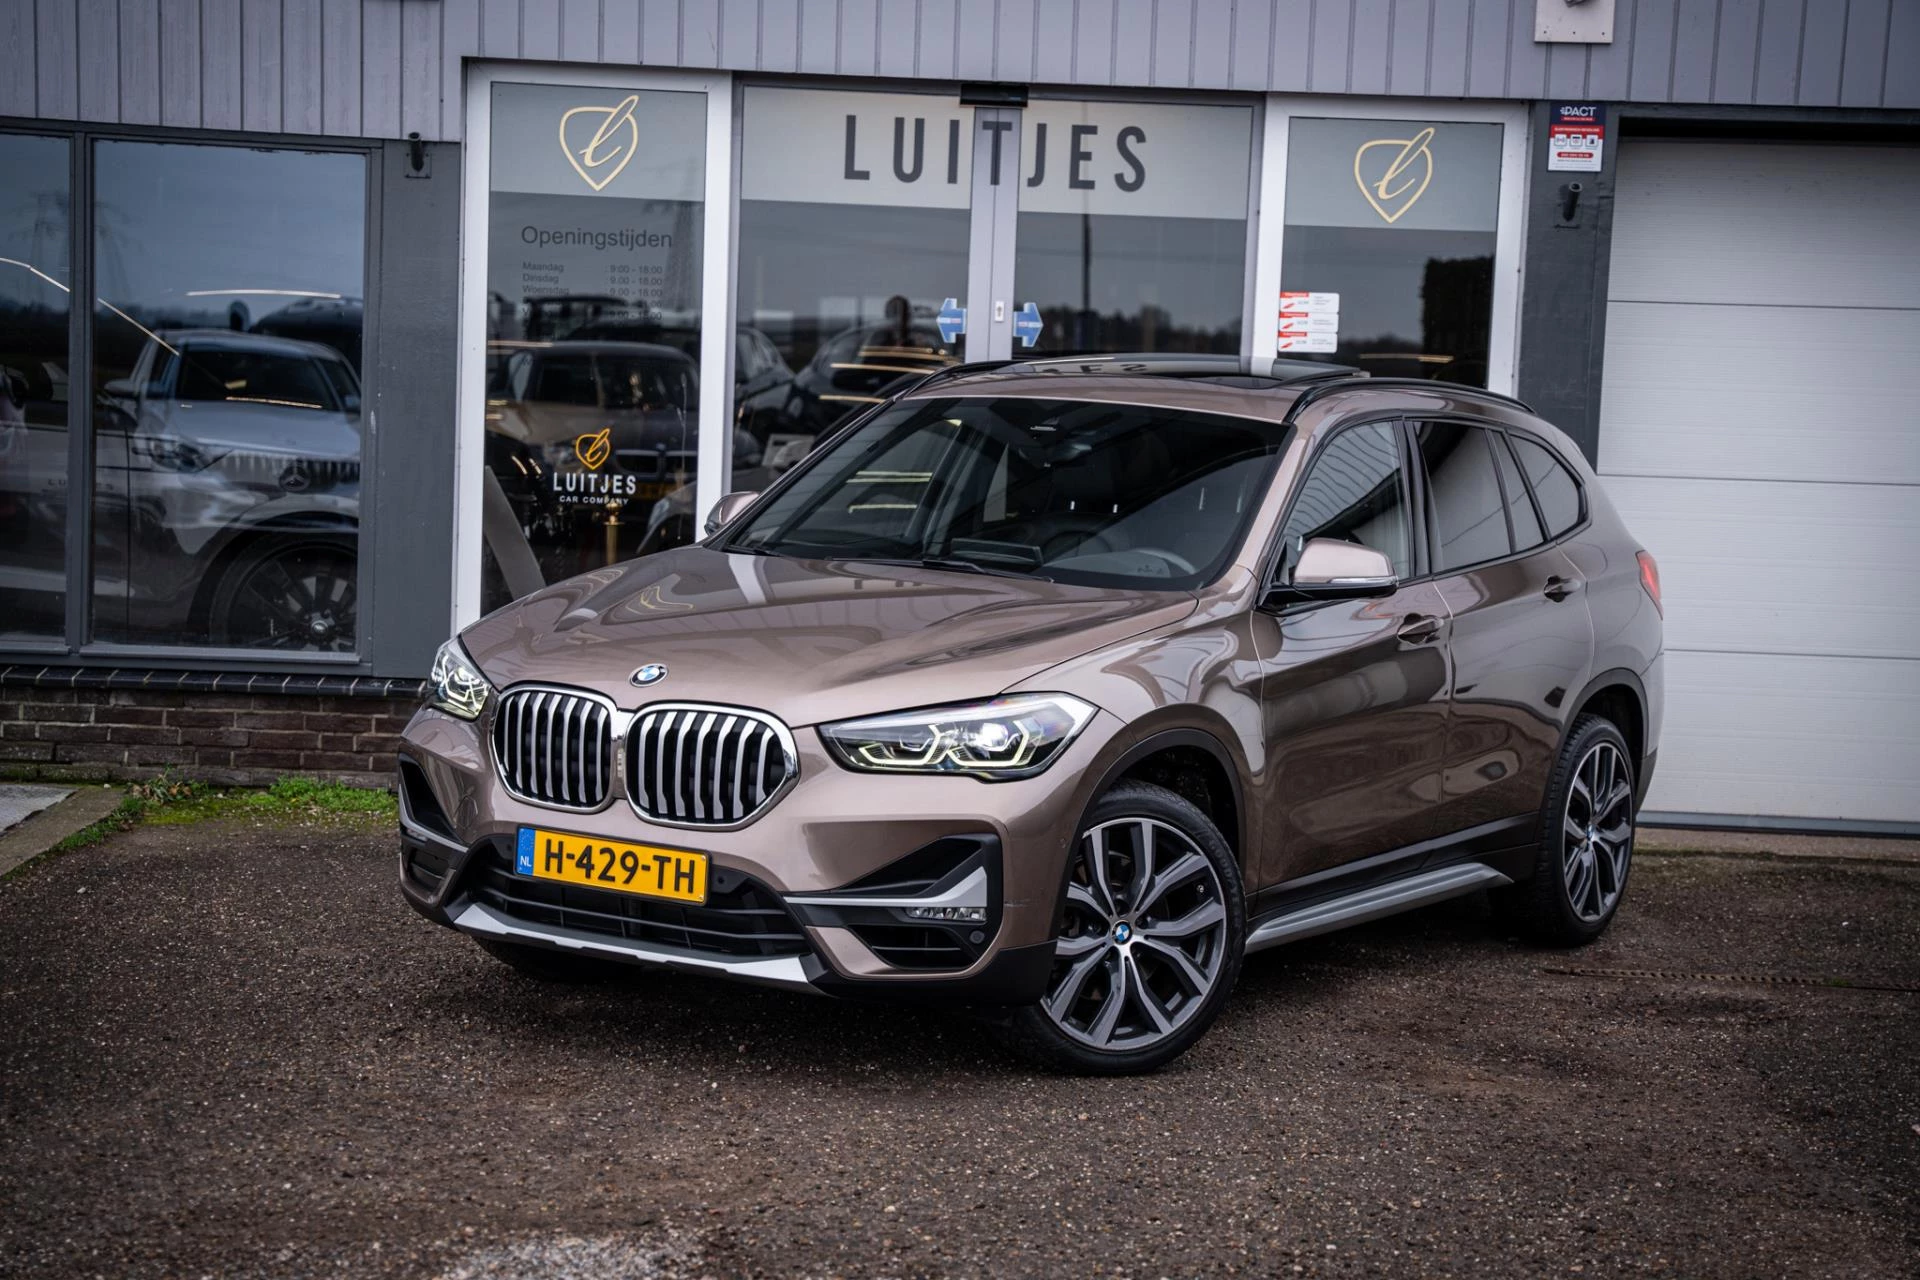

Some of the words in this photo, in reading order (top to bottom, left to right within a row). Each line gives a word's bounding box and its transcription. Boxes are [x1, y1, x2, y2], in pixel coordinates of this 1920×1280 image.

[844, 114, 1147, 193] LUITJES
[521, 225, 672, 251] Openingstijden
[522, 261, 564, 273] Maandag
[522, 273, 559, 284] Dinsdag
[553, 471, 637, 495] LUITJES
[559, 495, 578, 504] CAR
[582, 496, 629, 505] COMPANY
[519, 855, 532, 868] NL
[543, 838, 696, 894] H-429-TH
